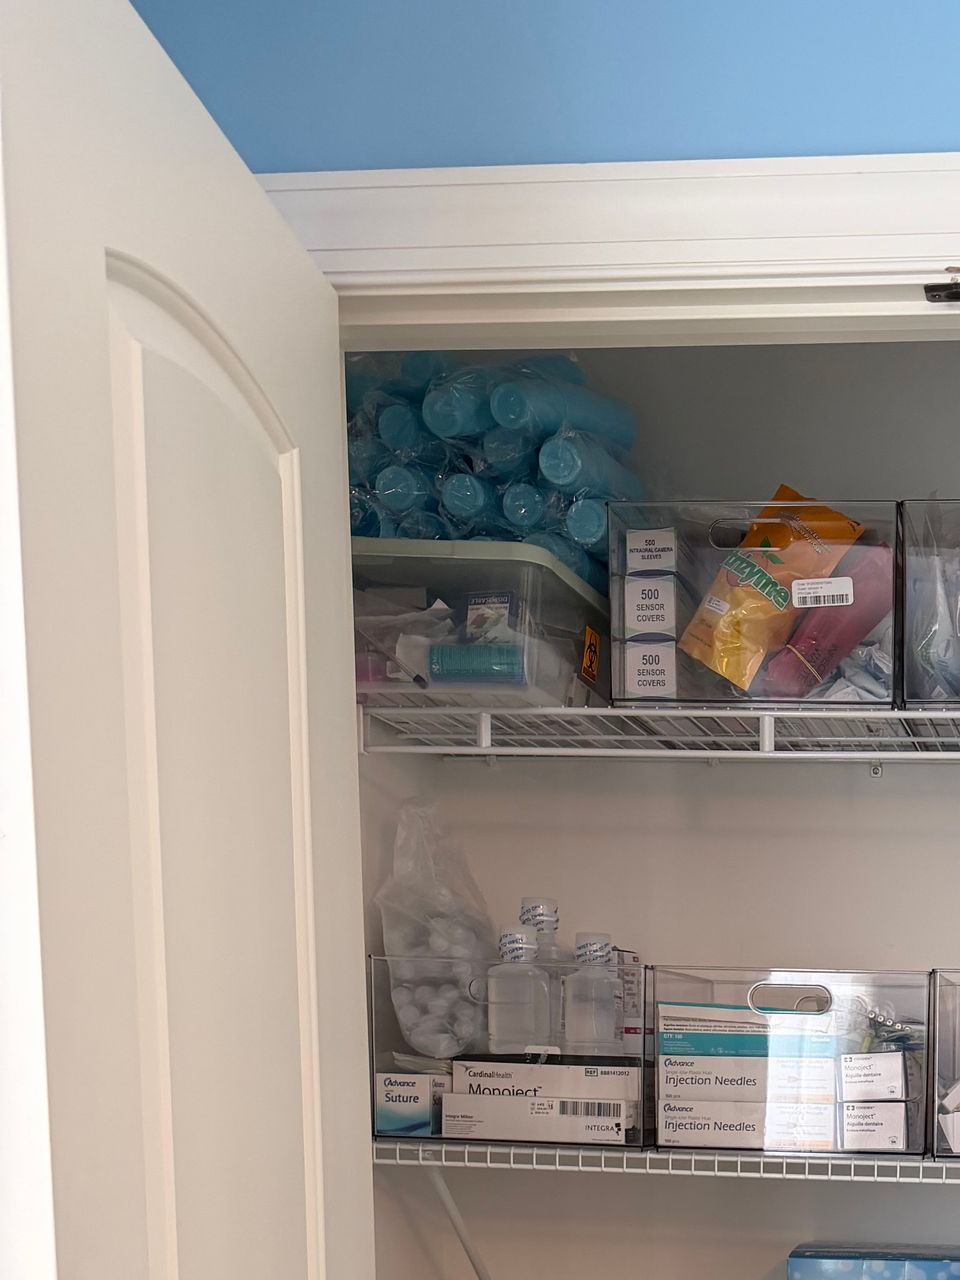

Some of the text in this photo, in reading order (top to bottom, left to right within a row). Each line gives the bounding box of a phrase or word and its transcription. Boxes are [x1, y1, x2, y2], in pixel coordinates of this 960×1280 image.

[641, 589, 659, 600] 500
[637, 614, 665, 622] COVERS
[642, 654, 660, 665] 500
[637, 679, 666, 687] COVERS
[664, 1058, 694, 1067] Advance
[384, 1078, 416, 1088] Advance
[665, 1075, 757, 1087] Injection Needles
[385, 1092, 419, 1104] Suture
[664, 1103, 693, 1112] Advance
[846, 1113, 873, 1121] Monoject
[664, 1121, 756, 1132] Injection Needles
